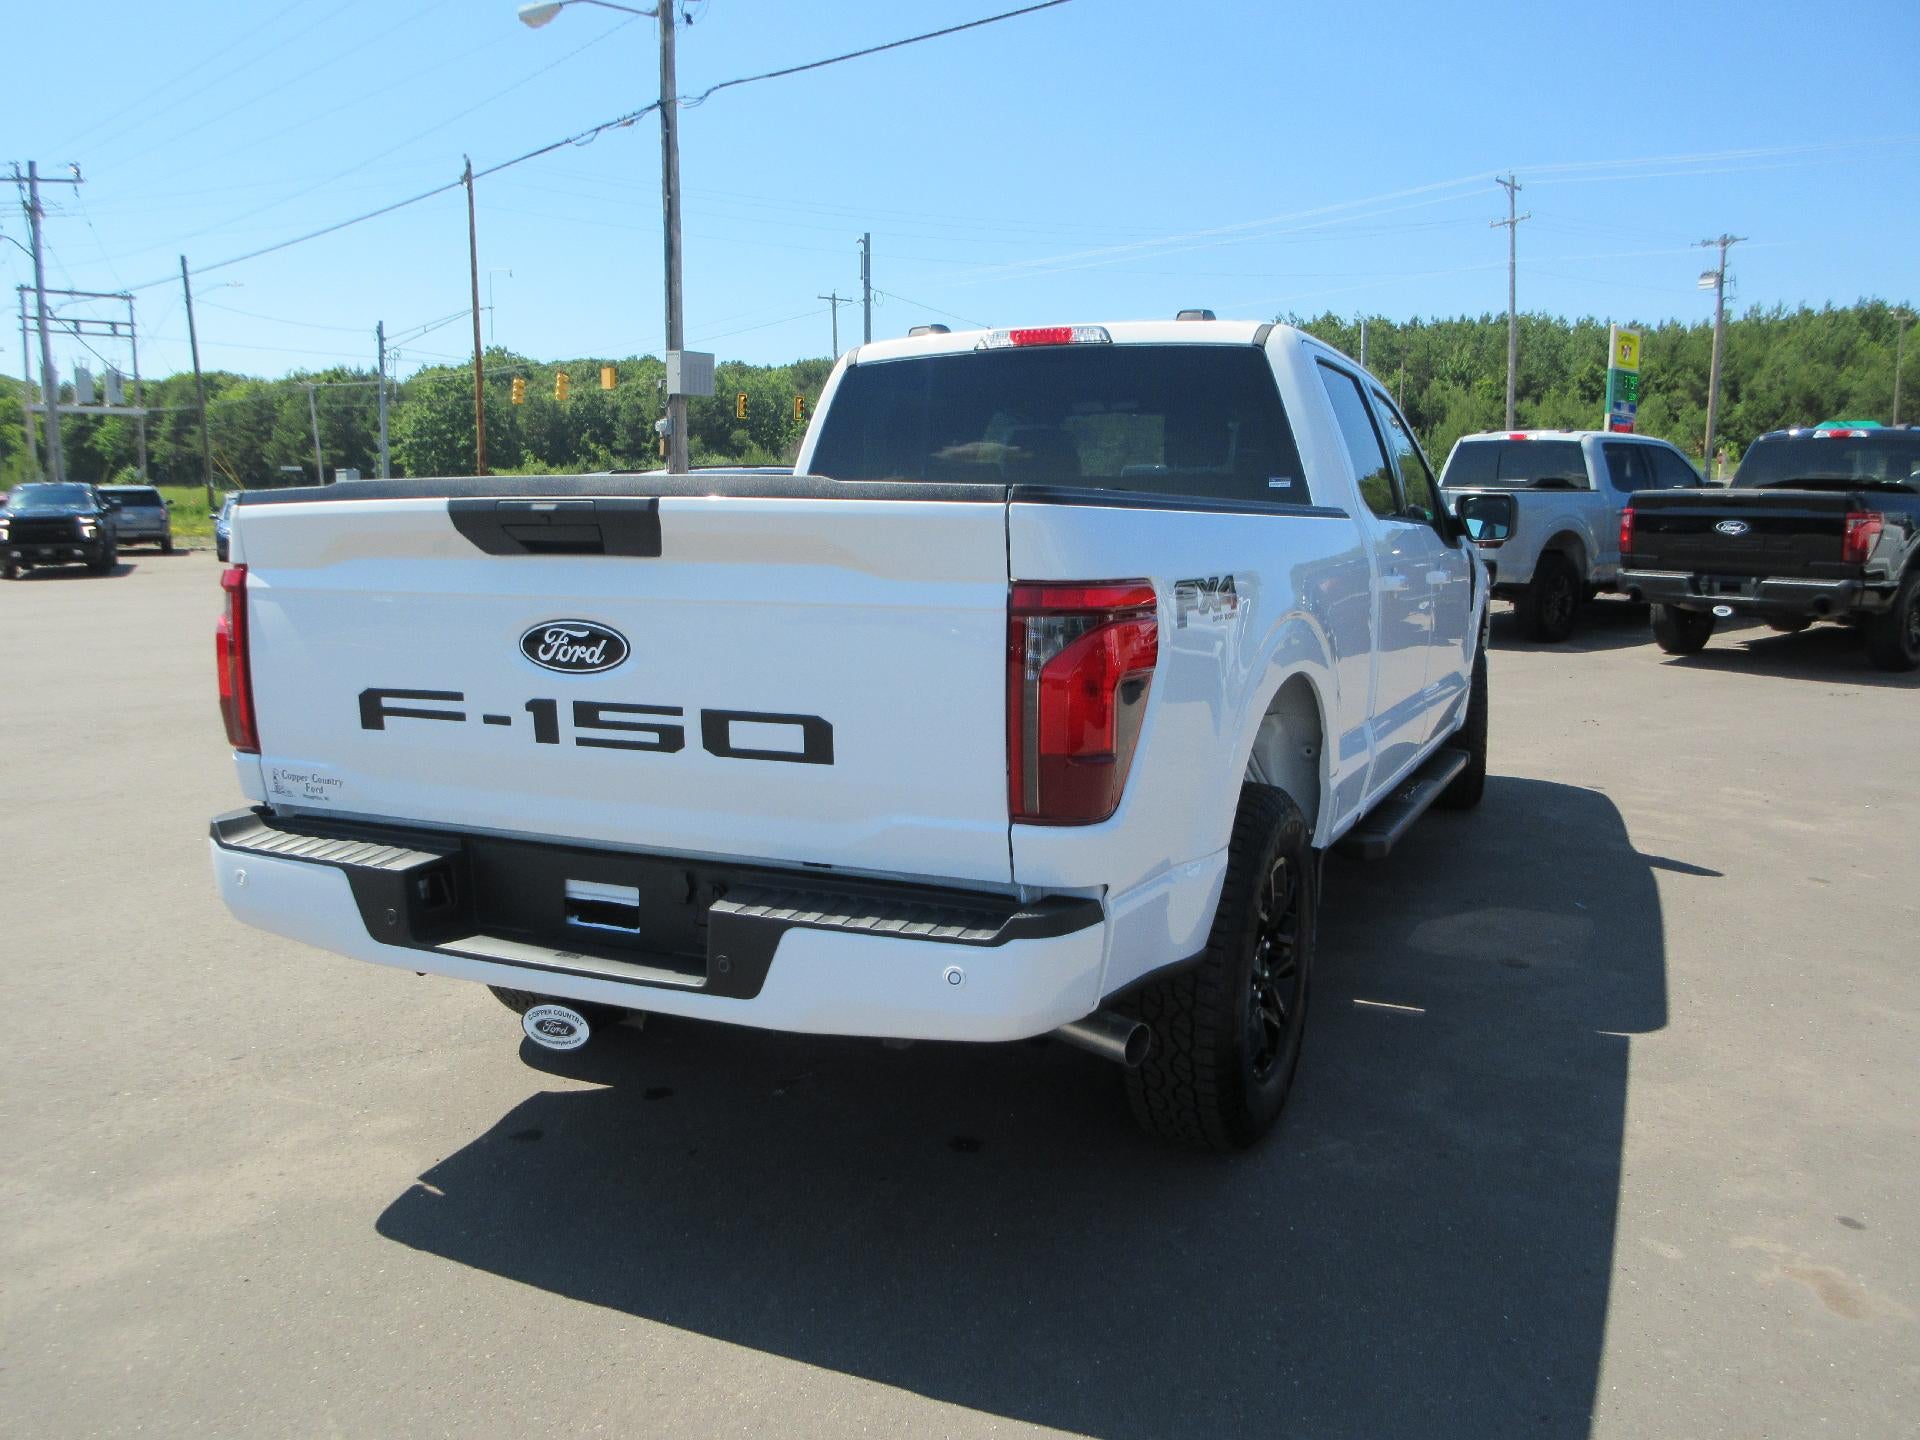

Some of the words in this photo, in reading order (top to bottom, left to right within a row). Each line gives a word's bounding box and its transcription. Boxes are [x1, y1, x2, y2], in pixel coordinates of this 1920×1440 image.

[1174, 575, 1237, 630] FX4
[538, 628, 607, 664] Ford
[358, 687, 834, 766] F-150
[281, 769, 308, 783] Copper
[312, 773, 344, 788] Country
[304, 782, 323, 794] Ford
[528, 1009, 552, 1021] COPPER
[553, 1010, 584, 1026] COUNTRY
[542, 1020, 569, 1035] Ford
